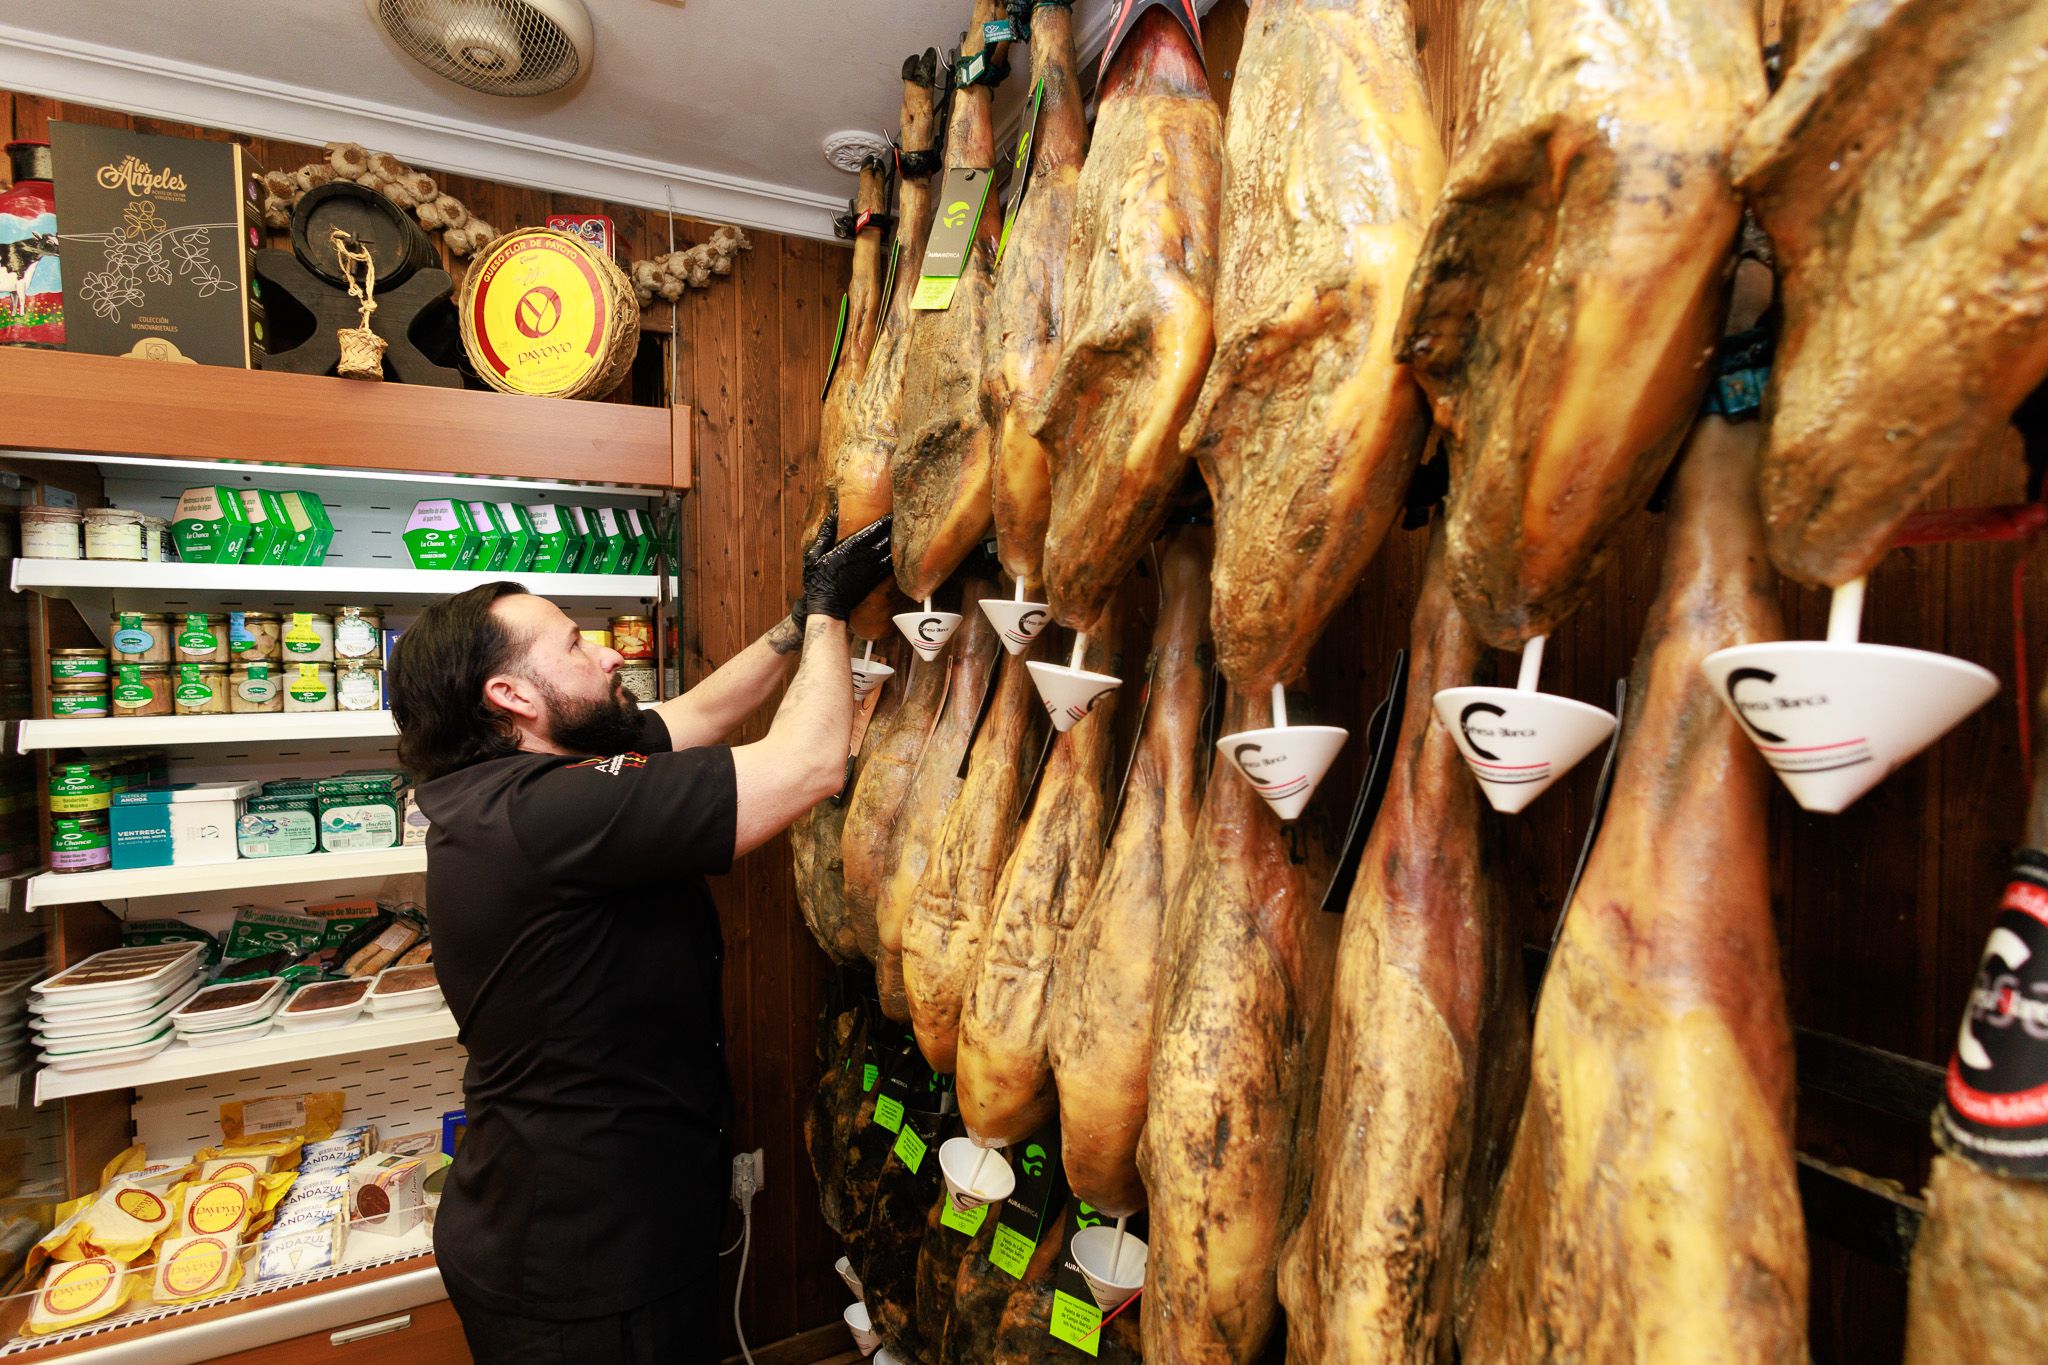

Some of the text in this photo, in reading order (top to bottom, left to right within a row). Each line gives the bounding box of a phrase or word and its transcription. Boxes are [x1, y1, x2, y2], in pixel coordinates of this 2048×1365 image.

[134, 158, 152, 174] los
[484, 255, 504, 283] QUESO
[504, 242, 526, 258] FLOR
[529, 239, 542, 248] DE
[545, 240, 578, 260] PAYOYO
[132, 323, 178, 332] MONOVARIETALES
[138, 316, 170, 324] COLECCIÓN
[306, 1151, 360, 1166] ANDAZUL
[290, 1185, 342, 1204] ANDAZUL
[280, 1208, 335, 1228] ANDAZUL
[267, 1234, 326, 1256] ANDAZUL
